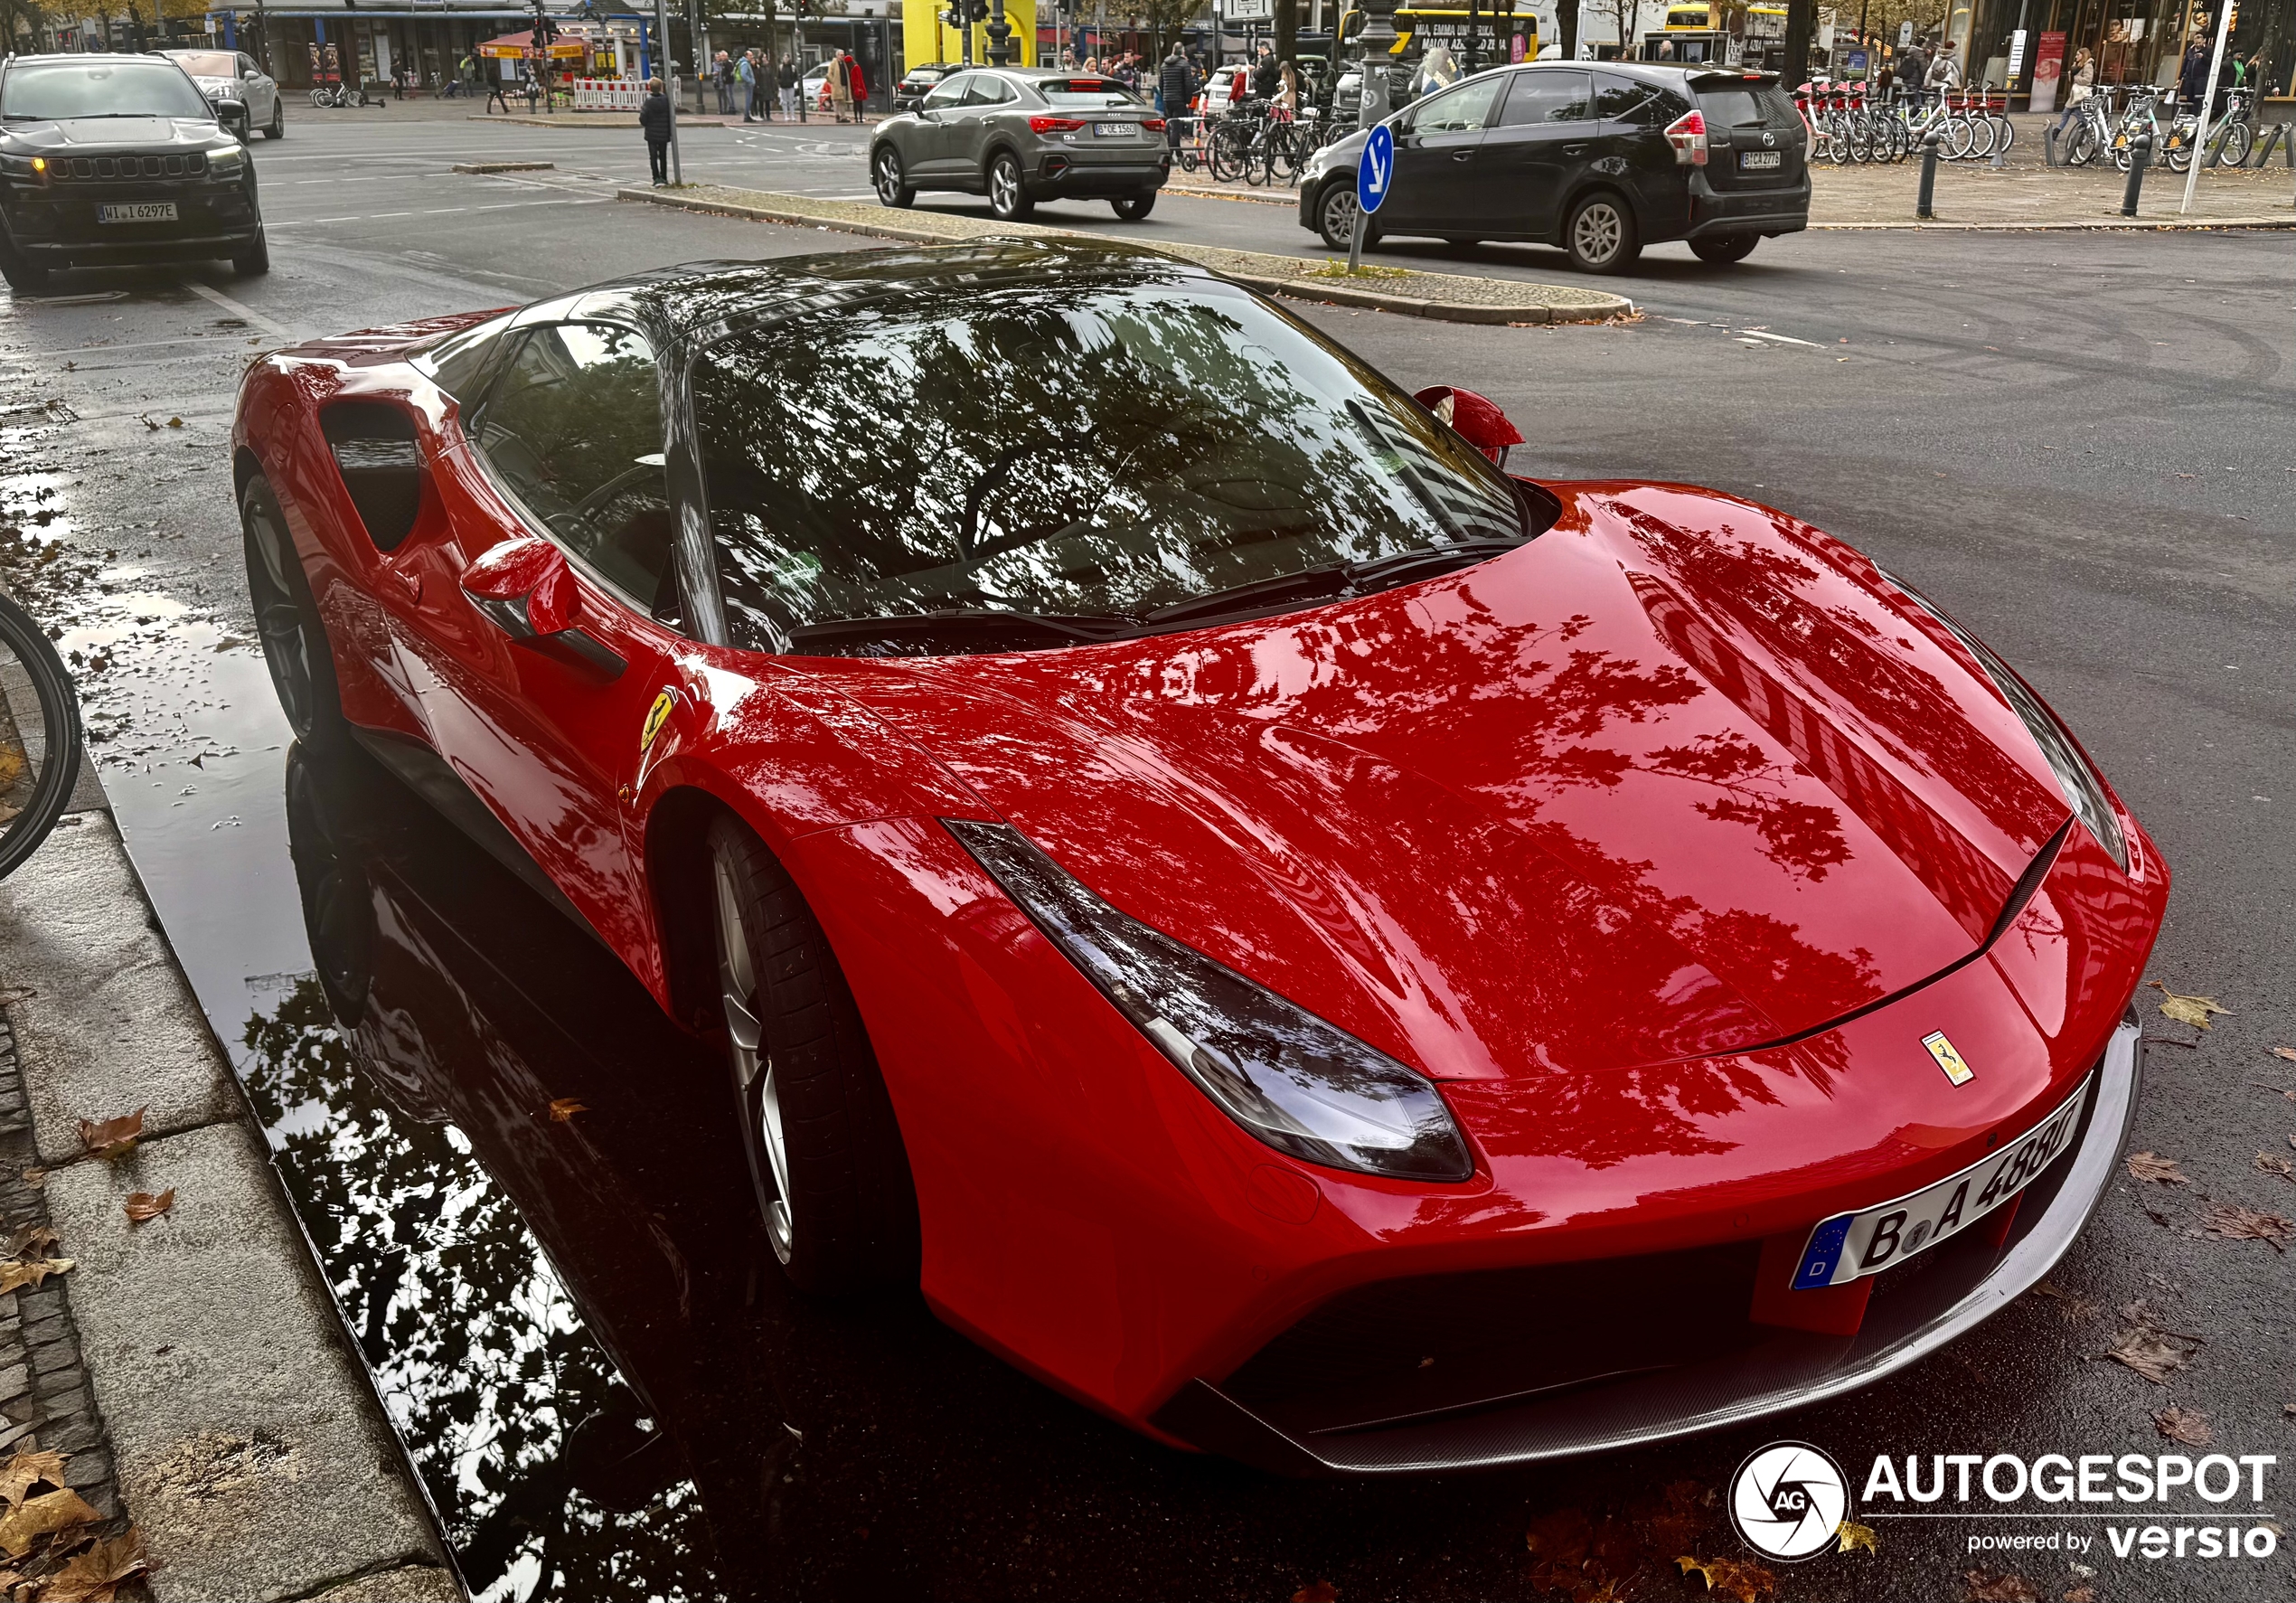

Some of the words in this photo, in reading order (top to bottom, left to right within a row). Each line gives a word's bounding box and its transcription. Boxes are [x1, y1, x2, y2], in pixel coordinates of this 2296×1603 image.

[1433, 24, 1455, 35] EMMA
[105, 206, 119, 219] WI
[137, 204, 174, 218] 6297E
[1809, 1261, 1826, 1277] D
[1858, 1209, 1908, 1269] B
[1932, 1176, 1971, 1239] A
[1974, 1098, 2078, 1208] 4880
